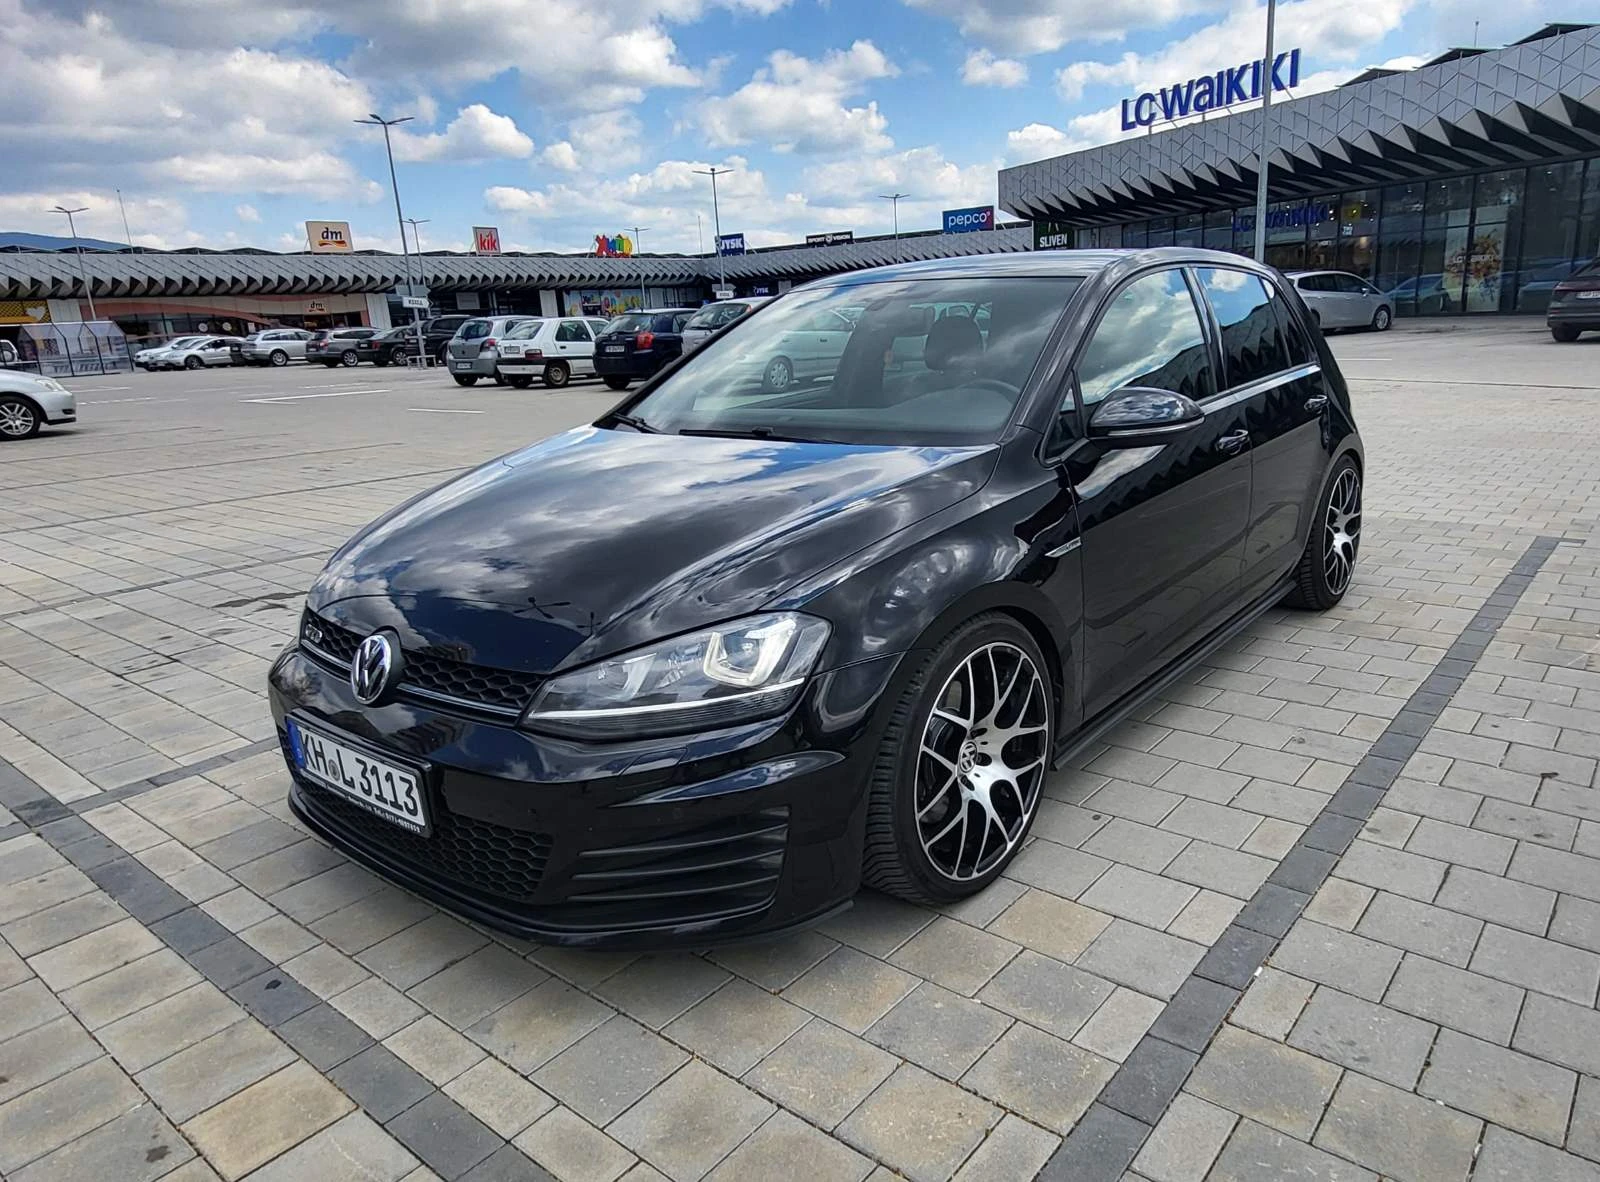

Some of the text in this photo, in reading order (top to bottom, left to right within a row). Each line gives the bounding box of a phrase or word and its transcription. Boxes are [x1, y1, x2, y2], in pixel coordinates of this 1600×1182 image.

[948, 213, 987, 229] pepco
[321, 227, 343, 240] dm
[1039, 233, 1068, 248] SLIVEN
[479, 231, 497, 251] kik
[720, 238, 743, 250] JYSK
[310, 301, 323, 309] dm
